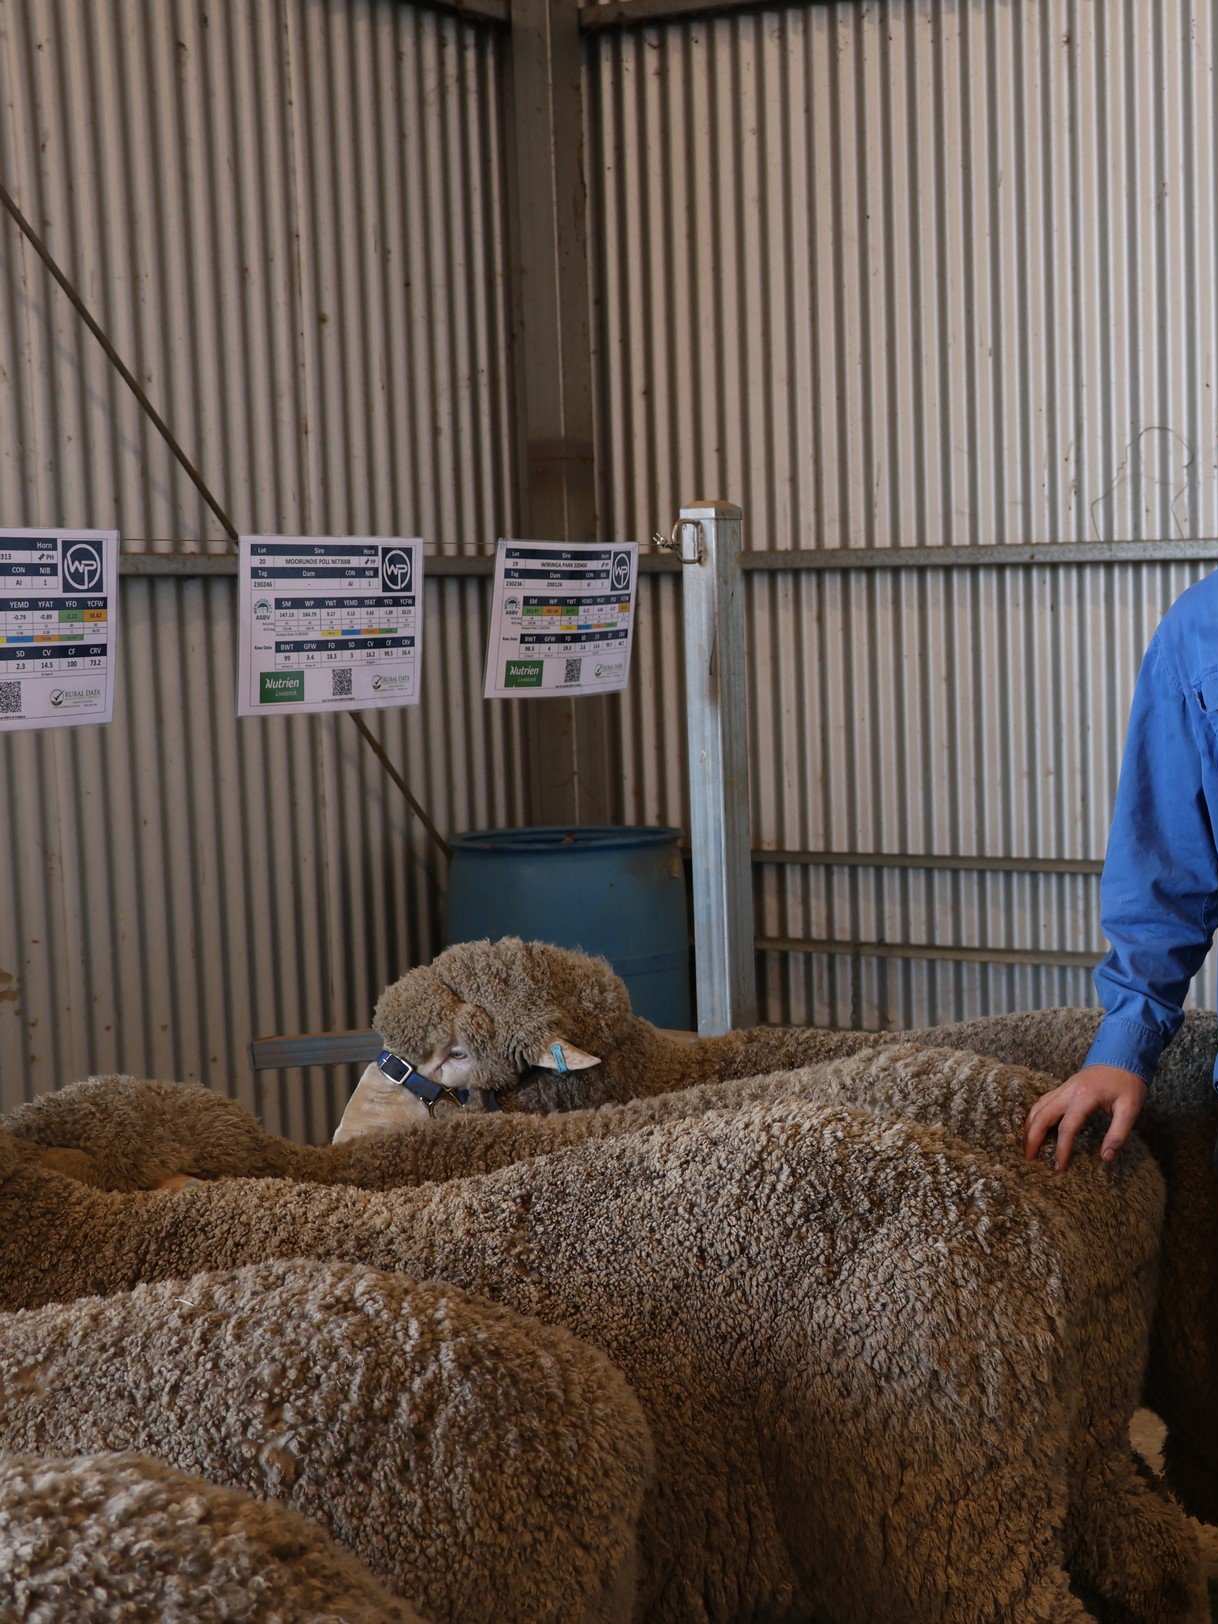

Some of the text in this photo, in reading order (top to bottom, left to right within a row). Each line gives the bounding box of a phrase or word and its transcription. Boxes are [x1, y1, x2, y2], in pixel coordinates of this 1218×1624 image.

[11, 566, 51, 575] CON NIB
[9, 601, 30, 609] YEMD
[37, 600, 54, 608] YFAT
[65, 600, 78, 608] YFD
[280, 643, 294, 651] BWT
[15, 646, 102, 658] SD CV CF CRV
[15, 659, 102, 670] 2.3 14.5 100 73.2
[509, 665, 539, 675] Nutrien
[265, 677, 300, 689] Nutrien
[65, 689, 101, 698] RURAL DATA
